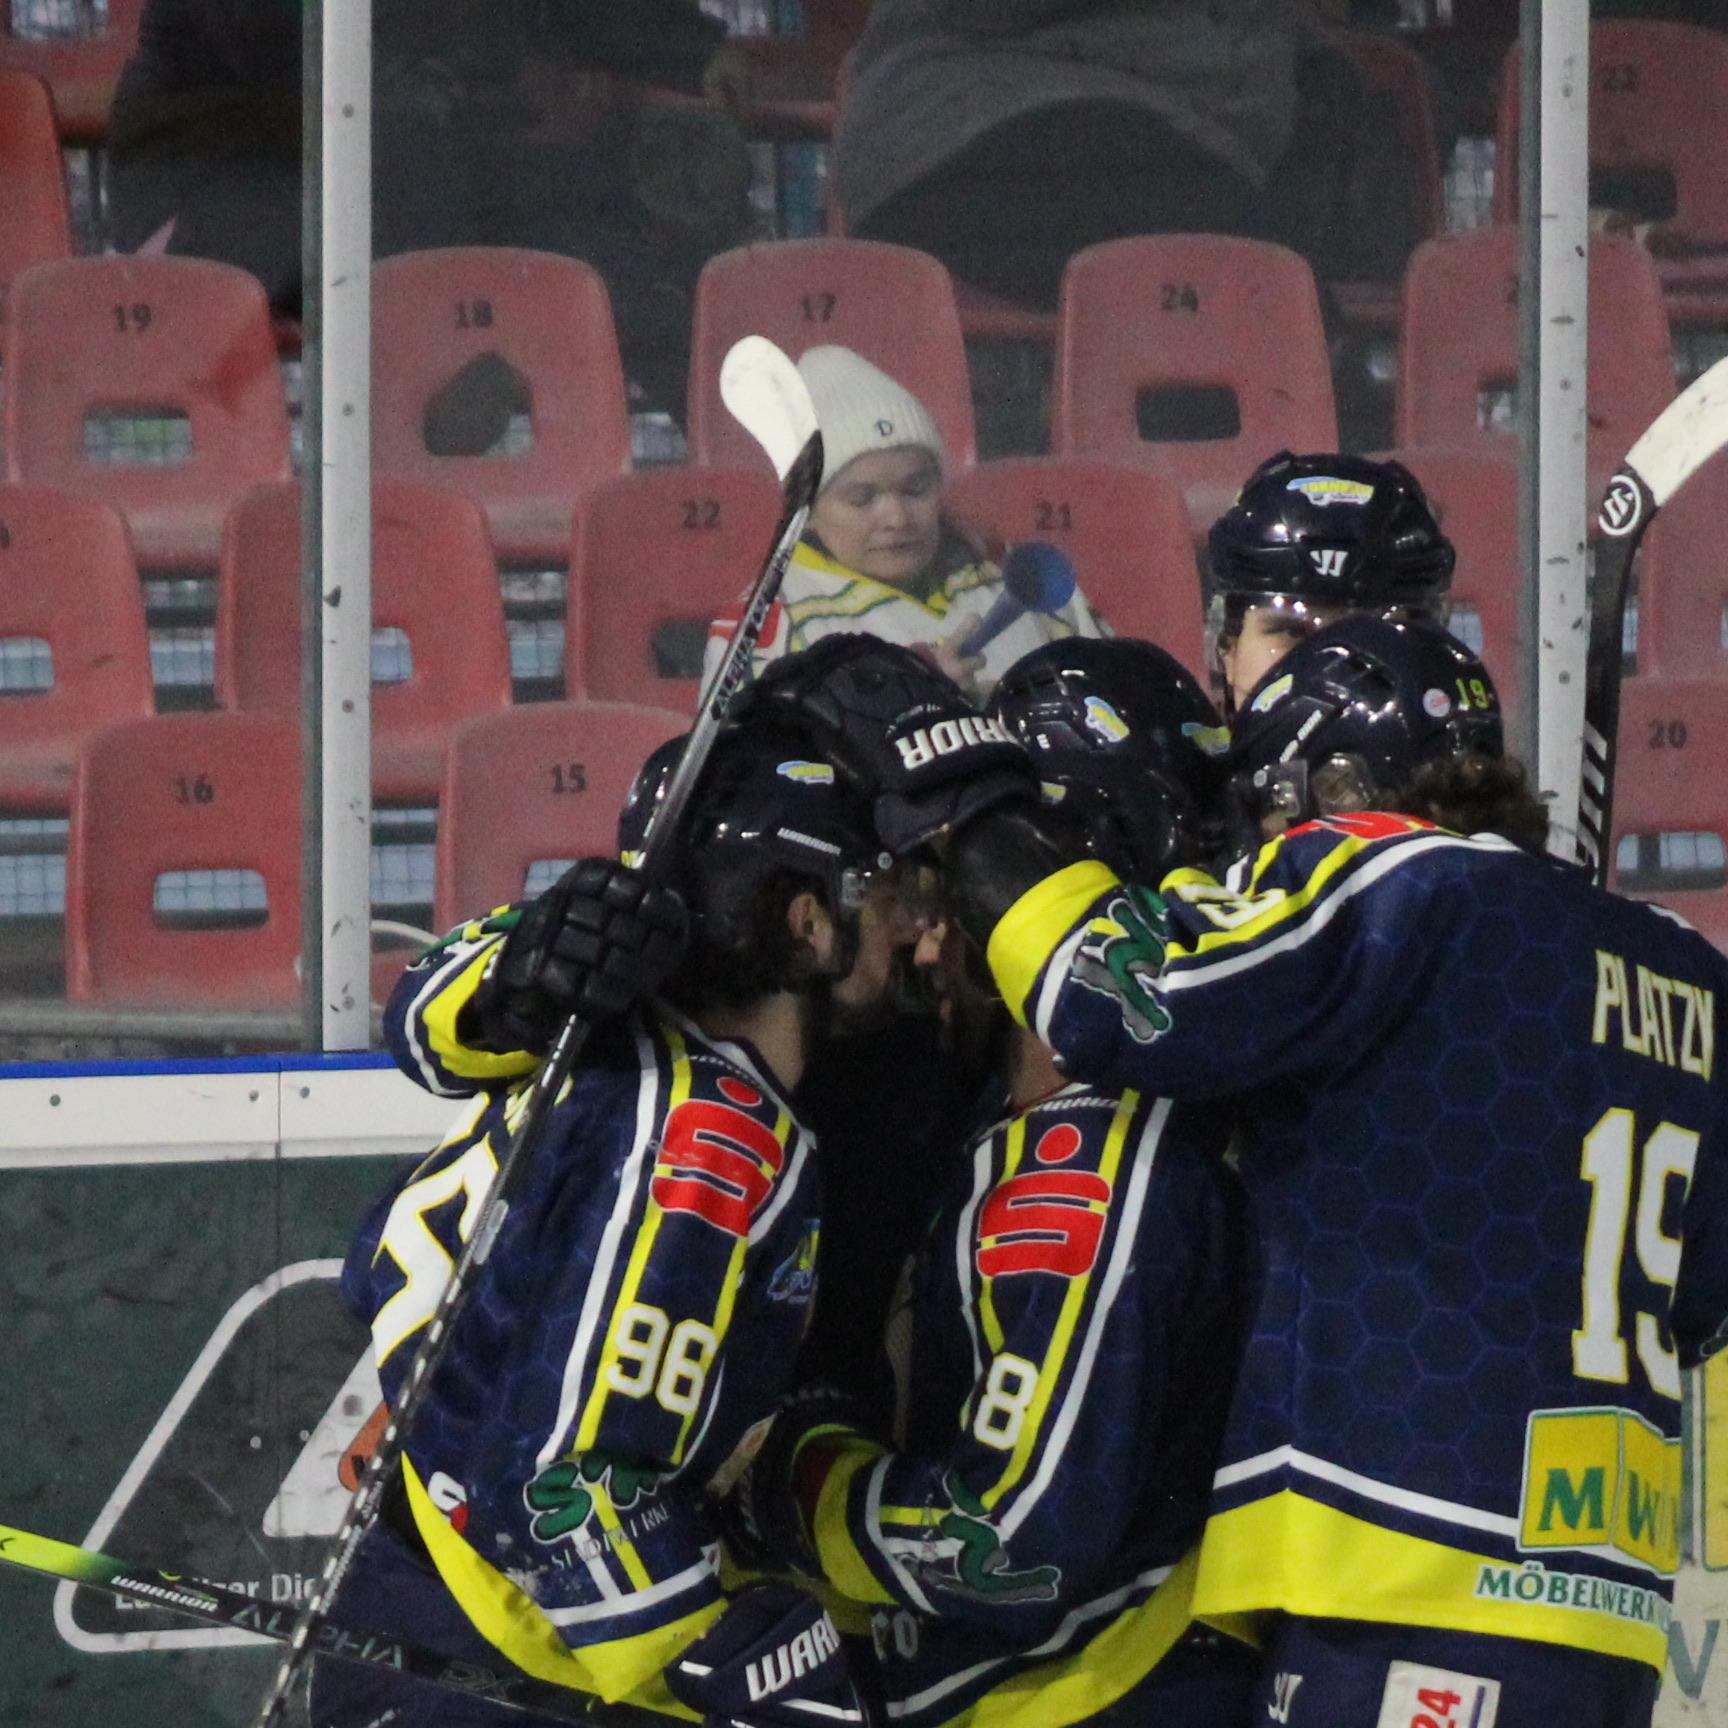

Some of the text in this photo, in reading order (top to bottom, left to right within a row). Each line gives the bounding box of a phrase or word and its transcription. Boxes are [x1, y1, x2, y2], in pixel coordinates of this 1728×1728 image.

[800, 292, 838, 323] 17
[1161, 283, 1199, 314] 24
[112, 304, 153, 334] 19
[549, 763, 587, 795] 15
[972, 1352, 1040, 1452] 8
[110, 1574, 220, 1613] WARRIOR
